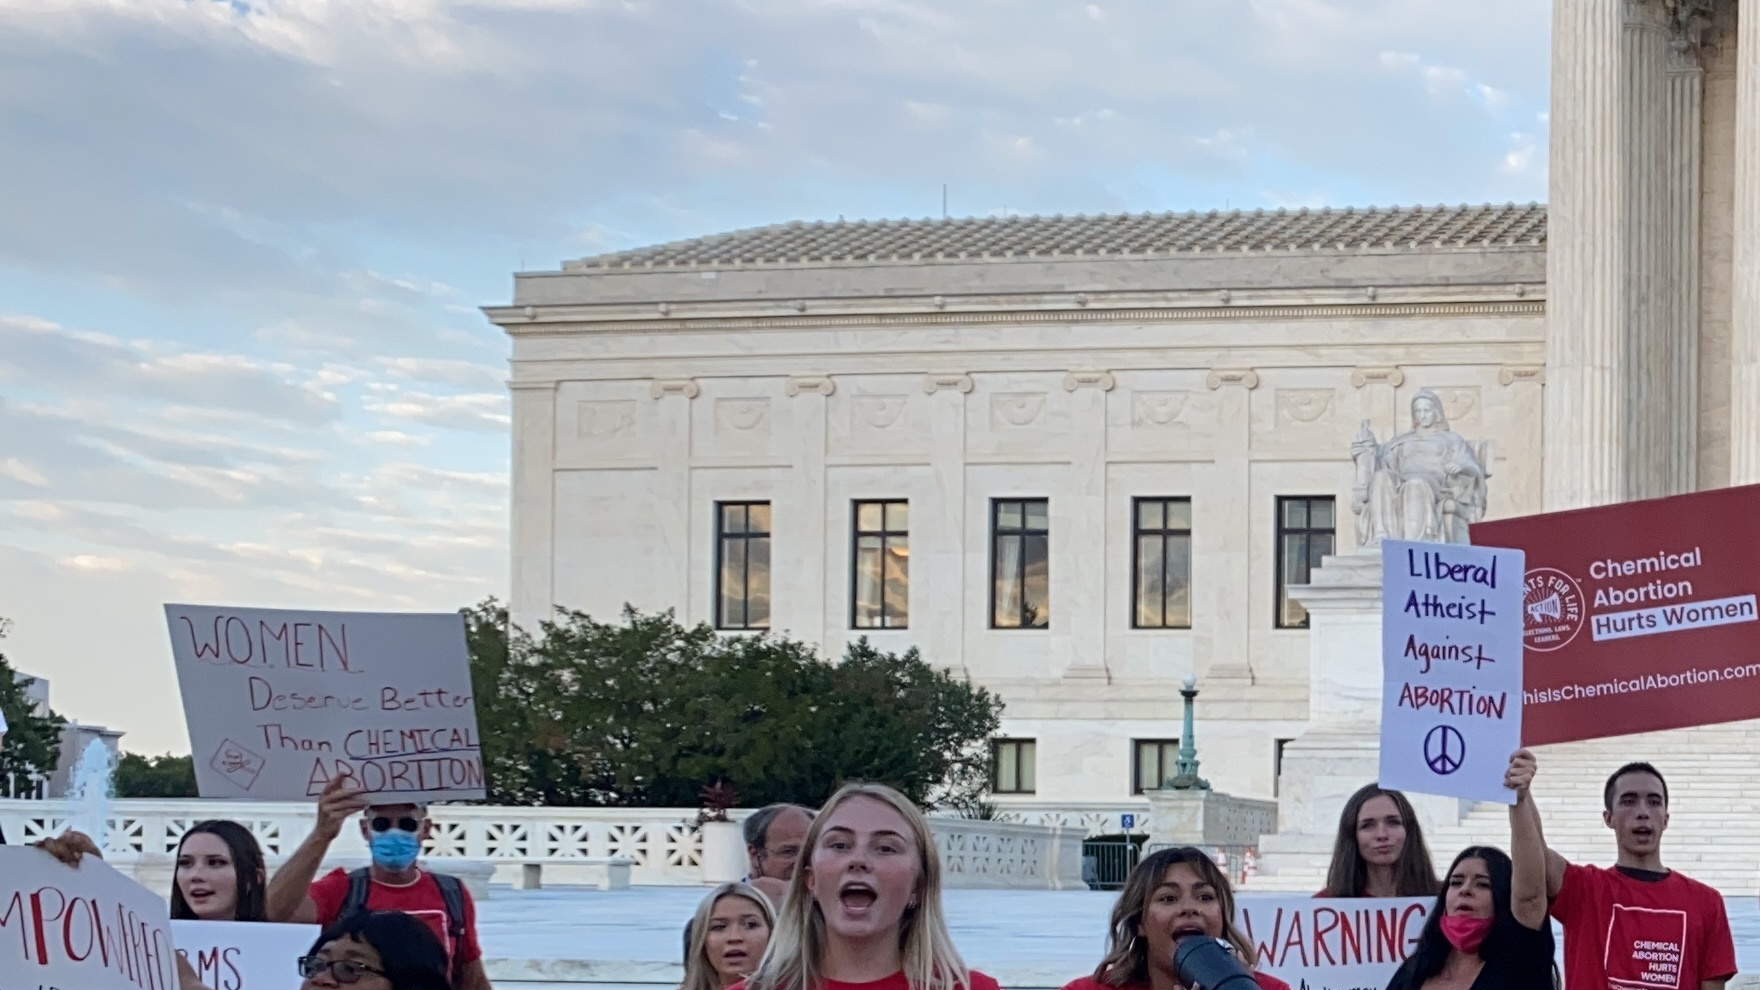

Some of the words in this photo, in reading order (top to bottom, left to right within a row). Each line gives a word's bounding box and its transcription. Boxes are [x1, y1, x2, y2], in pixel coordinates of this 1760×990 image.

[1589, 547, 1702, 580] Chemical
[1548, 576, 1570, 595] FOR
[1593, 577, 1693, 608] Abortion
[1404, 589, 1497, 624] Atheist
[1530, 598, 1559, 614] ACTION
[1565, 594, 1579, 621] LIFE
[1596, 612, 1657, 637] Hurts
[1665, 600, 1754, 629] Women
[180, 615, 350, 673] WOMEN
[1404, 634, 1496, 674] Against
[249, 676, 369, 711] Deserve
[381, 686, 473, 711] Better
[256, 723, 333, 751] Than
[343, 728, 480, 757] CHEMICAL
[306, 757, 484, 796] ABORTION
[1243, 903, 1427, 968] WARNING
[1633, 940, 1681, 952] CHEMICAL
[1631, 950, 1680, 962] ABORTION
[1648, 962, 1678, 973] HURTS
[1640, 971, 1677, 984] WOMEN
